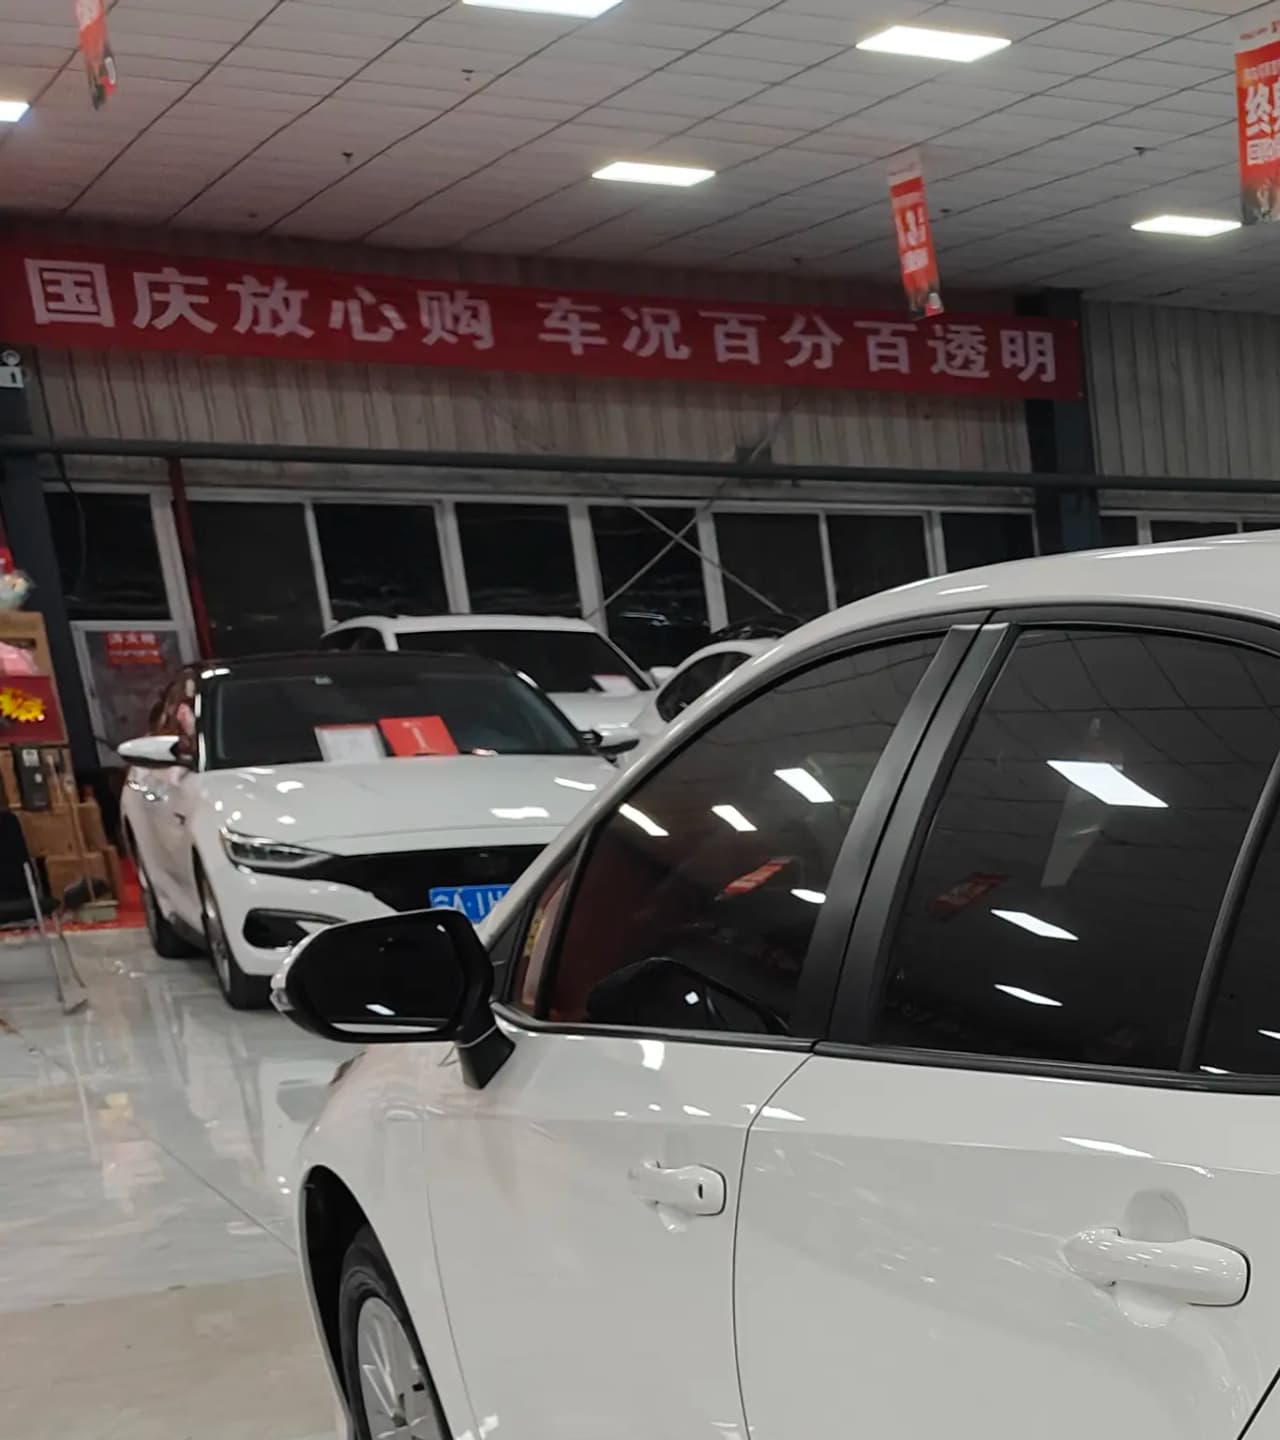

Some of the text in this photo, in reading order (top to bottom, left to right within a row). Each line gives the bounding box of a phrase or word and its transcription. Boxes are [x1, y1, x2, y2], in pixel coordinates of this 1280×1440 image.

[24, 258, 1057, 382] 国庆放心购 车况百分百透明
